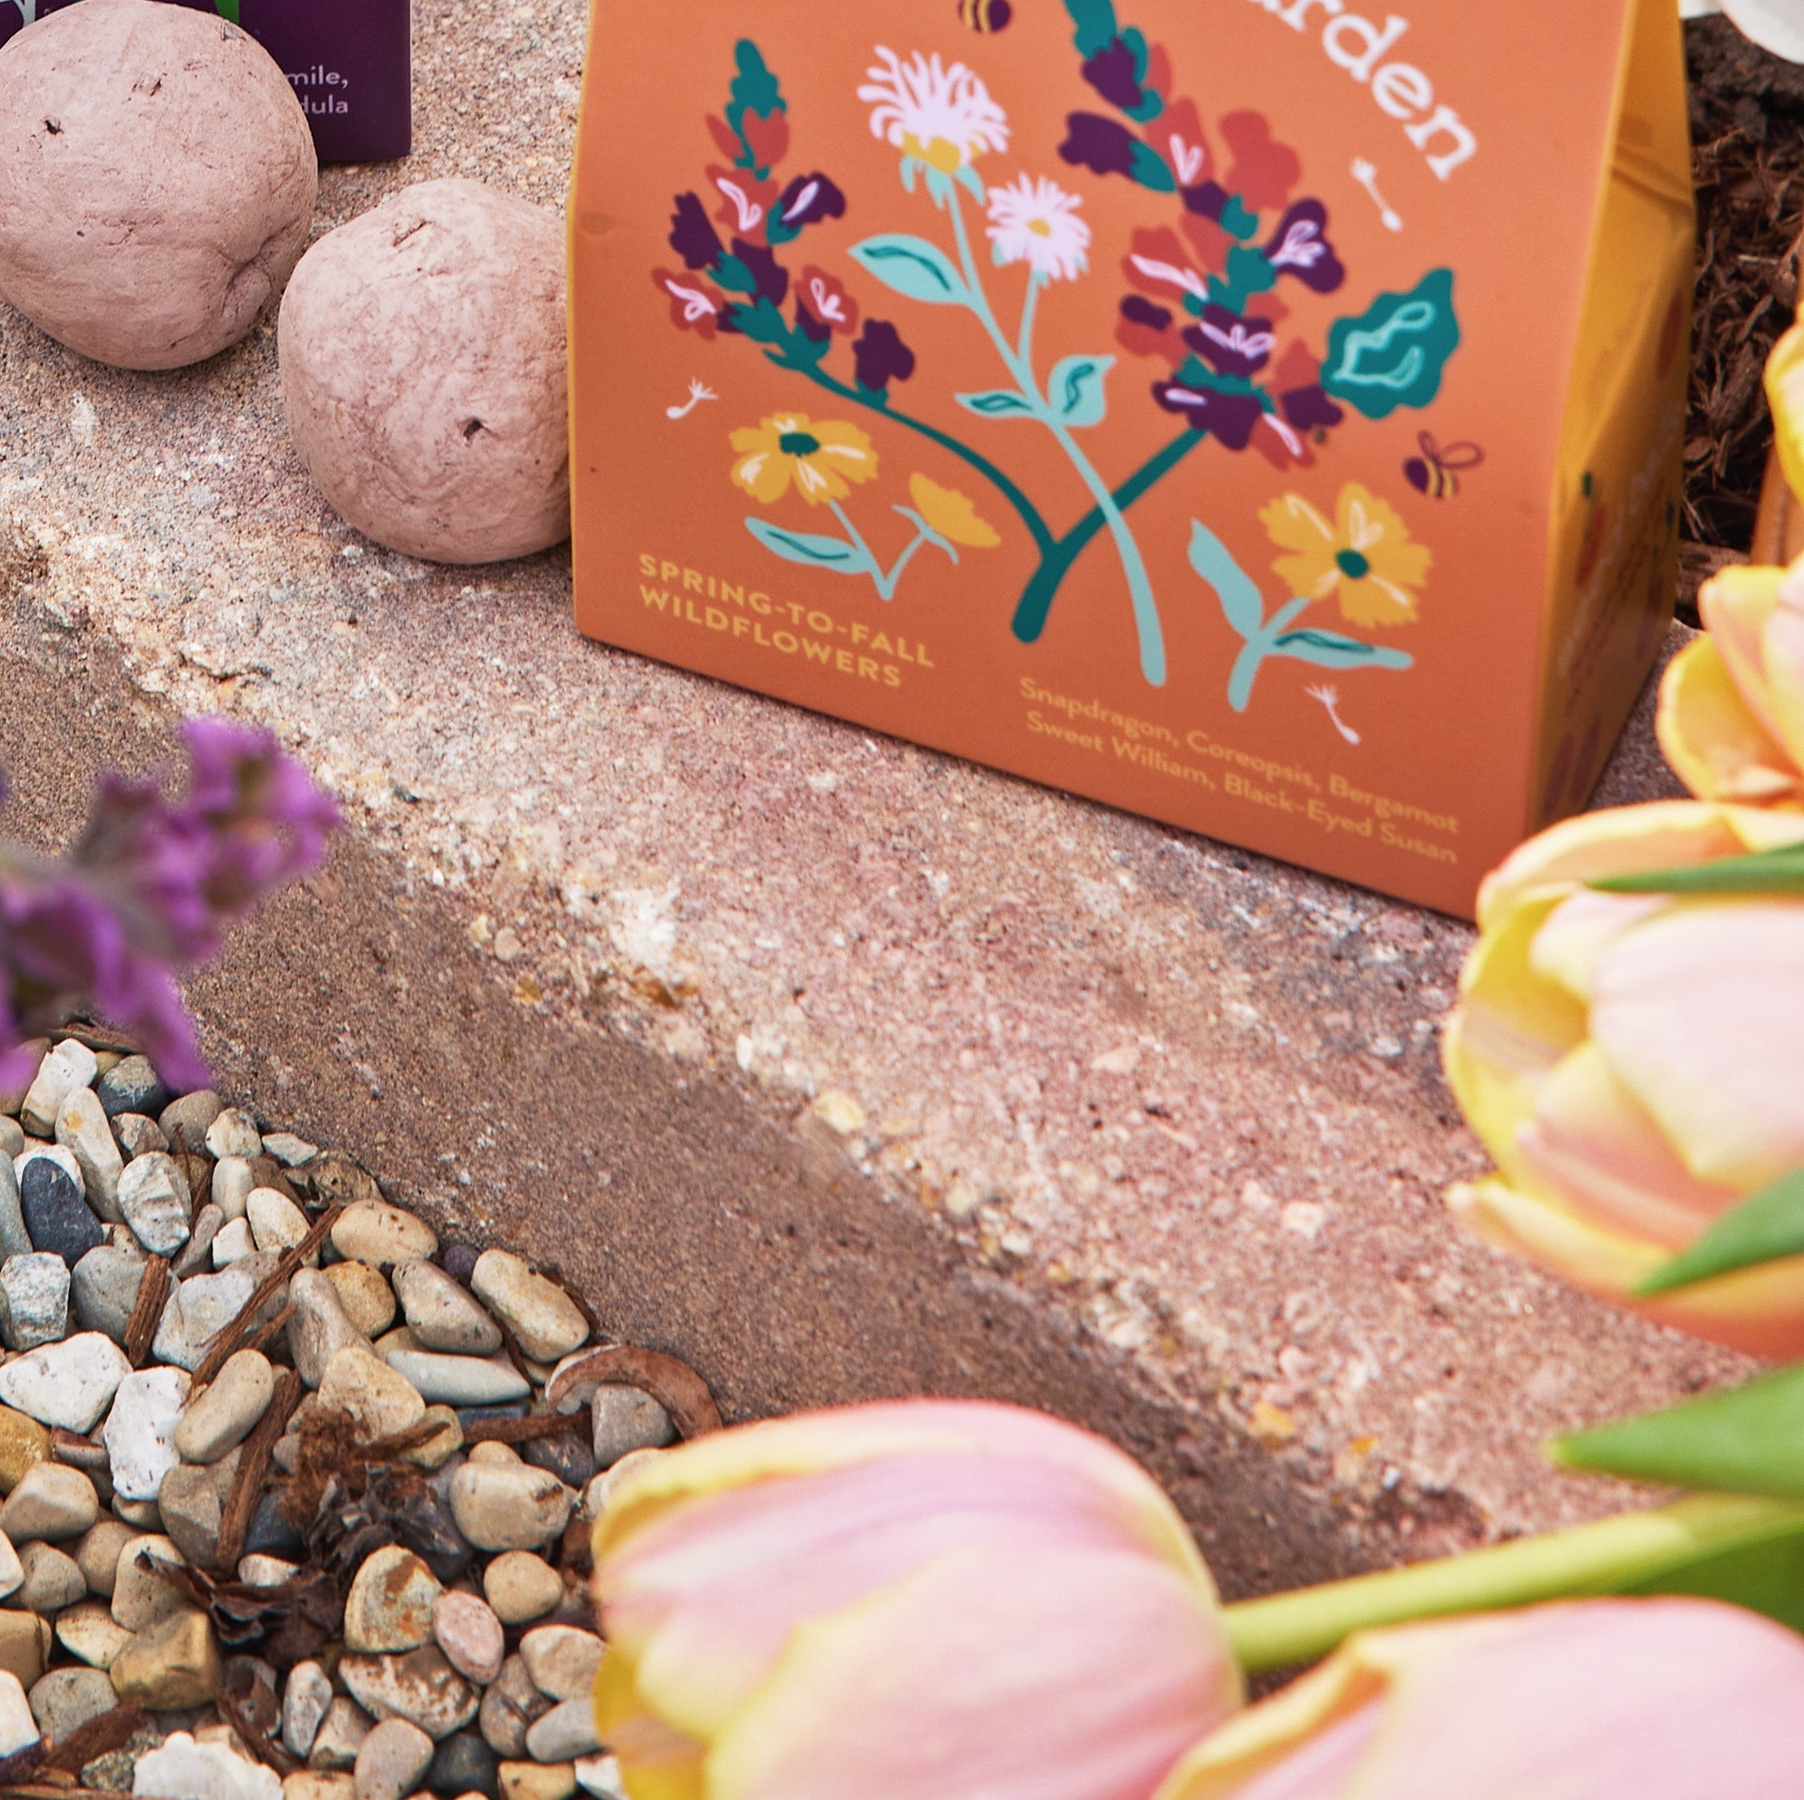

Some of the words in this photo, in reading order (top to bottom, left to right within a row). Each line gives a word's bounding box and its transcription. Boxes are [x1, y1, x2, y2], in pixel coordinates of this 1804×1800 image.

[639, 553, 936, 669] SPRING-TO-FALL
[639, 584, 902, 689] WILDFLOWERS
[1019, 676, 1180, 749] Snapdragon,
[1186, 730, 1322, 793] Coreopsis,
[1328, 774, 1461, 835] Bergamot
[1026, 710, 1105, 754] Sweet
[1110, 736, 1218, 792] William,
[1224, 772, 1374, 841] Black-Eyed
[1380, 823, 1459, 865] Susan
